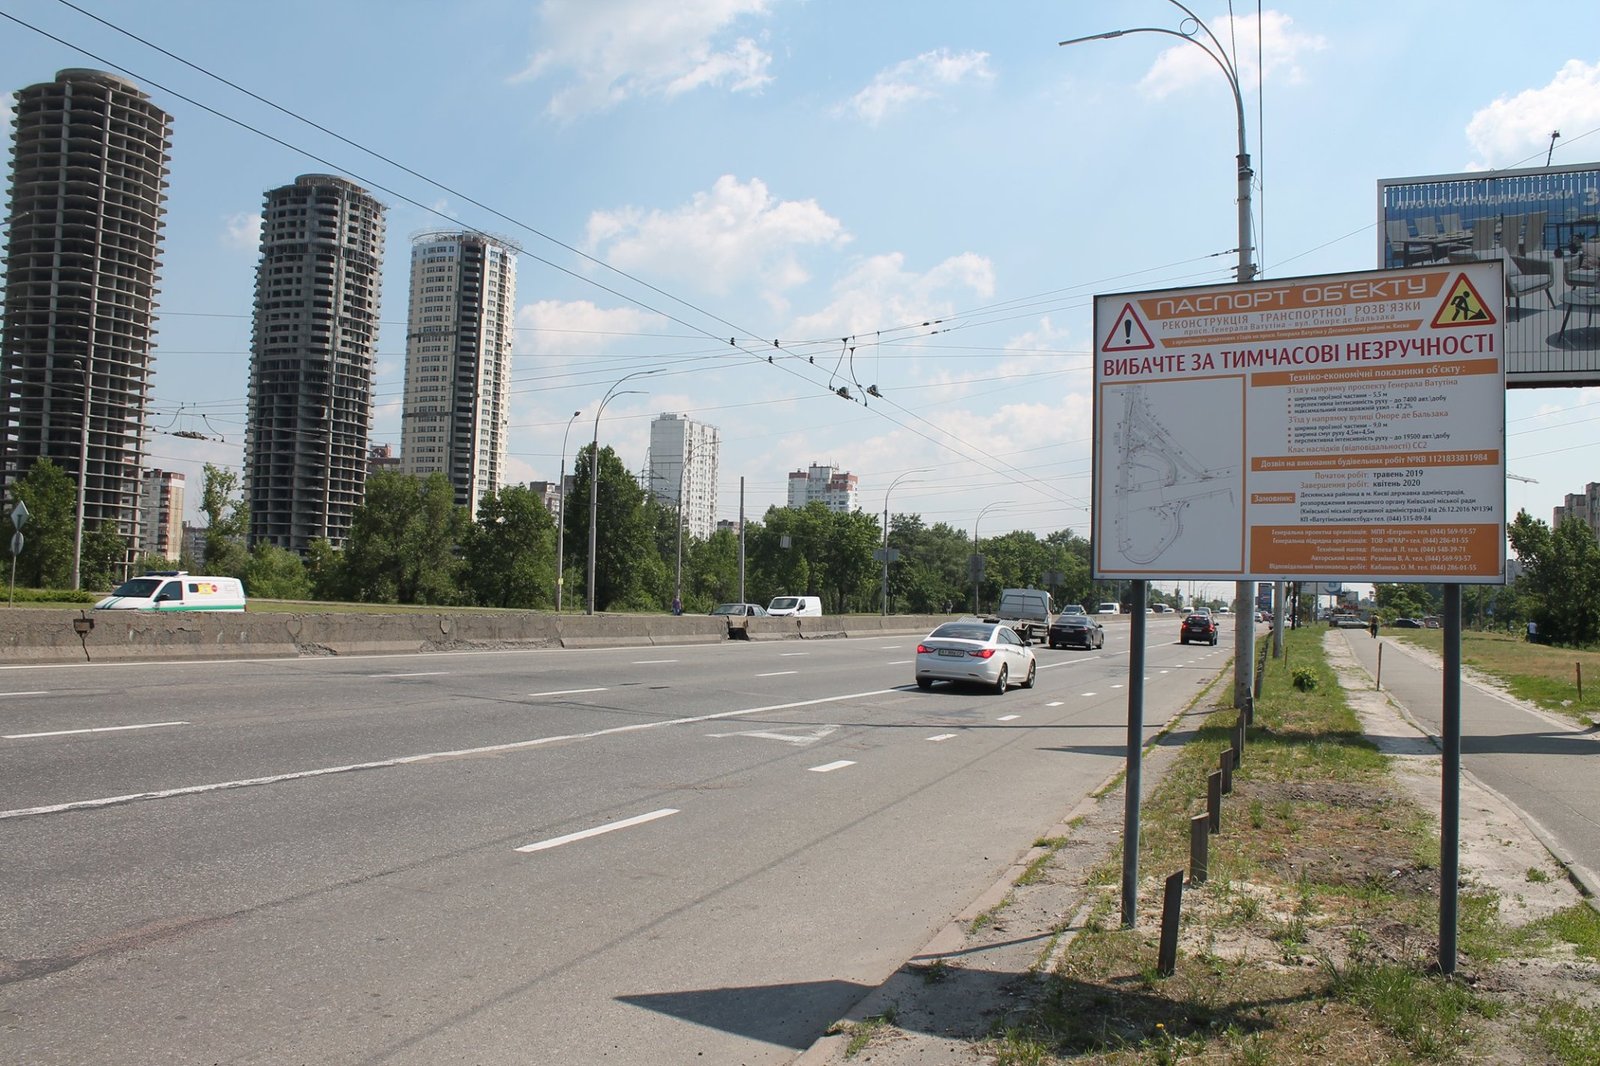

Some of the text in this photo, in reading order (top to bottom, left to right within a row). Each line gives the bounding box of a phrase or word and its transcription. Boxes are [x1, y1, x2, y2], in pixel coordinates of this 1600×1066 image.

[1157, 290, 1290, 315] ПАСПОРТ
[1162, 301, 1421, 330] РЕКОНСТРУКЦІЯ ТРАНСПОРТНОЇ РОЗВ'ЯЗКИ
[1184, 313, 1395, 336] просп. Генерала Ватутіна вул. Оноре де Бальзака
[1103, 333, 1494, 377] ВИБАЧТЕ ЗА ТИМЧАСОВІ НЕЗРУЧНОСТІ
[1289, 370, 1373, 382] Техніко-економічні
[1375, 367, 1424, 377] показники
[1311, 385, 1347, 393] напрямку
[1348, 383, 1387, 392] проспекту
[1388, 381, 1423, 389] Генерала
[1424, 378, 1458, 387] Ватутіна
[1349, 413, 1374, 422] вулиці
[1375, 412, 1400, 421] Оноре
[1412, 410, 1448, 418] Бальзака
[1306, 444, 1340, 452] наслідків
[1341, 443, 1411, 452] (відповідальності)
[1261, 459, 1285, 468] Дозвіл
[1297, 459, 1336, 467] виконання
[1337, 457, 1383, 467] будівельних
[1384, 455, 1405, 466] робіт
[1406, 455, 1426, 463] №КВ
[1314, 472, 1346, 480] Початок
[1347, 471, 1369, 480] робіт:
[1347, 480, 1369, 489] робіт:
[1402, 479, 1421, 487] 2020
[1422, 537, 1438, 545] (044)
